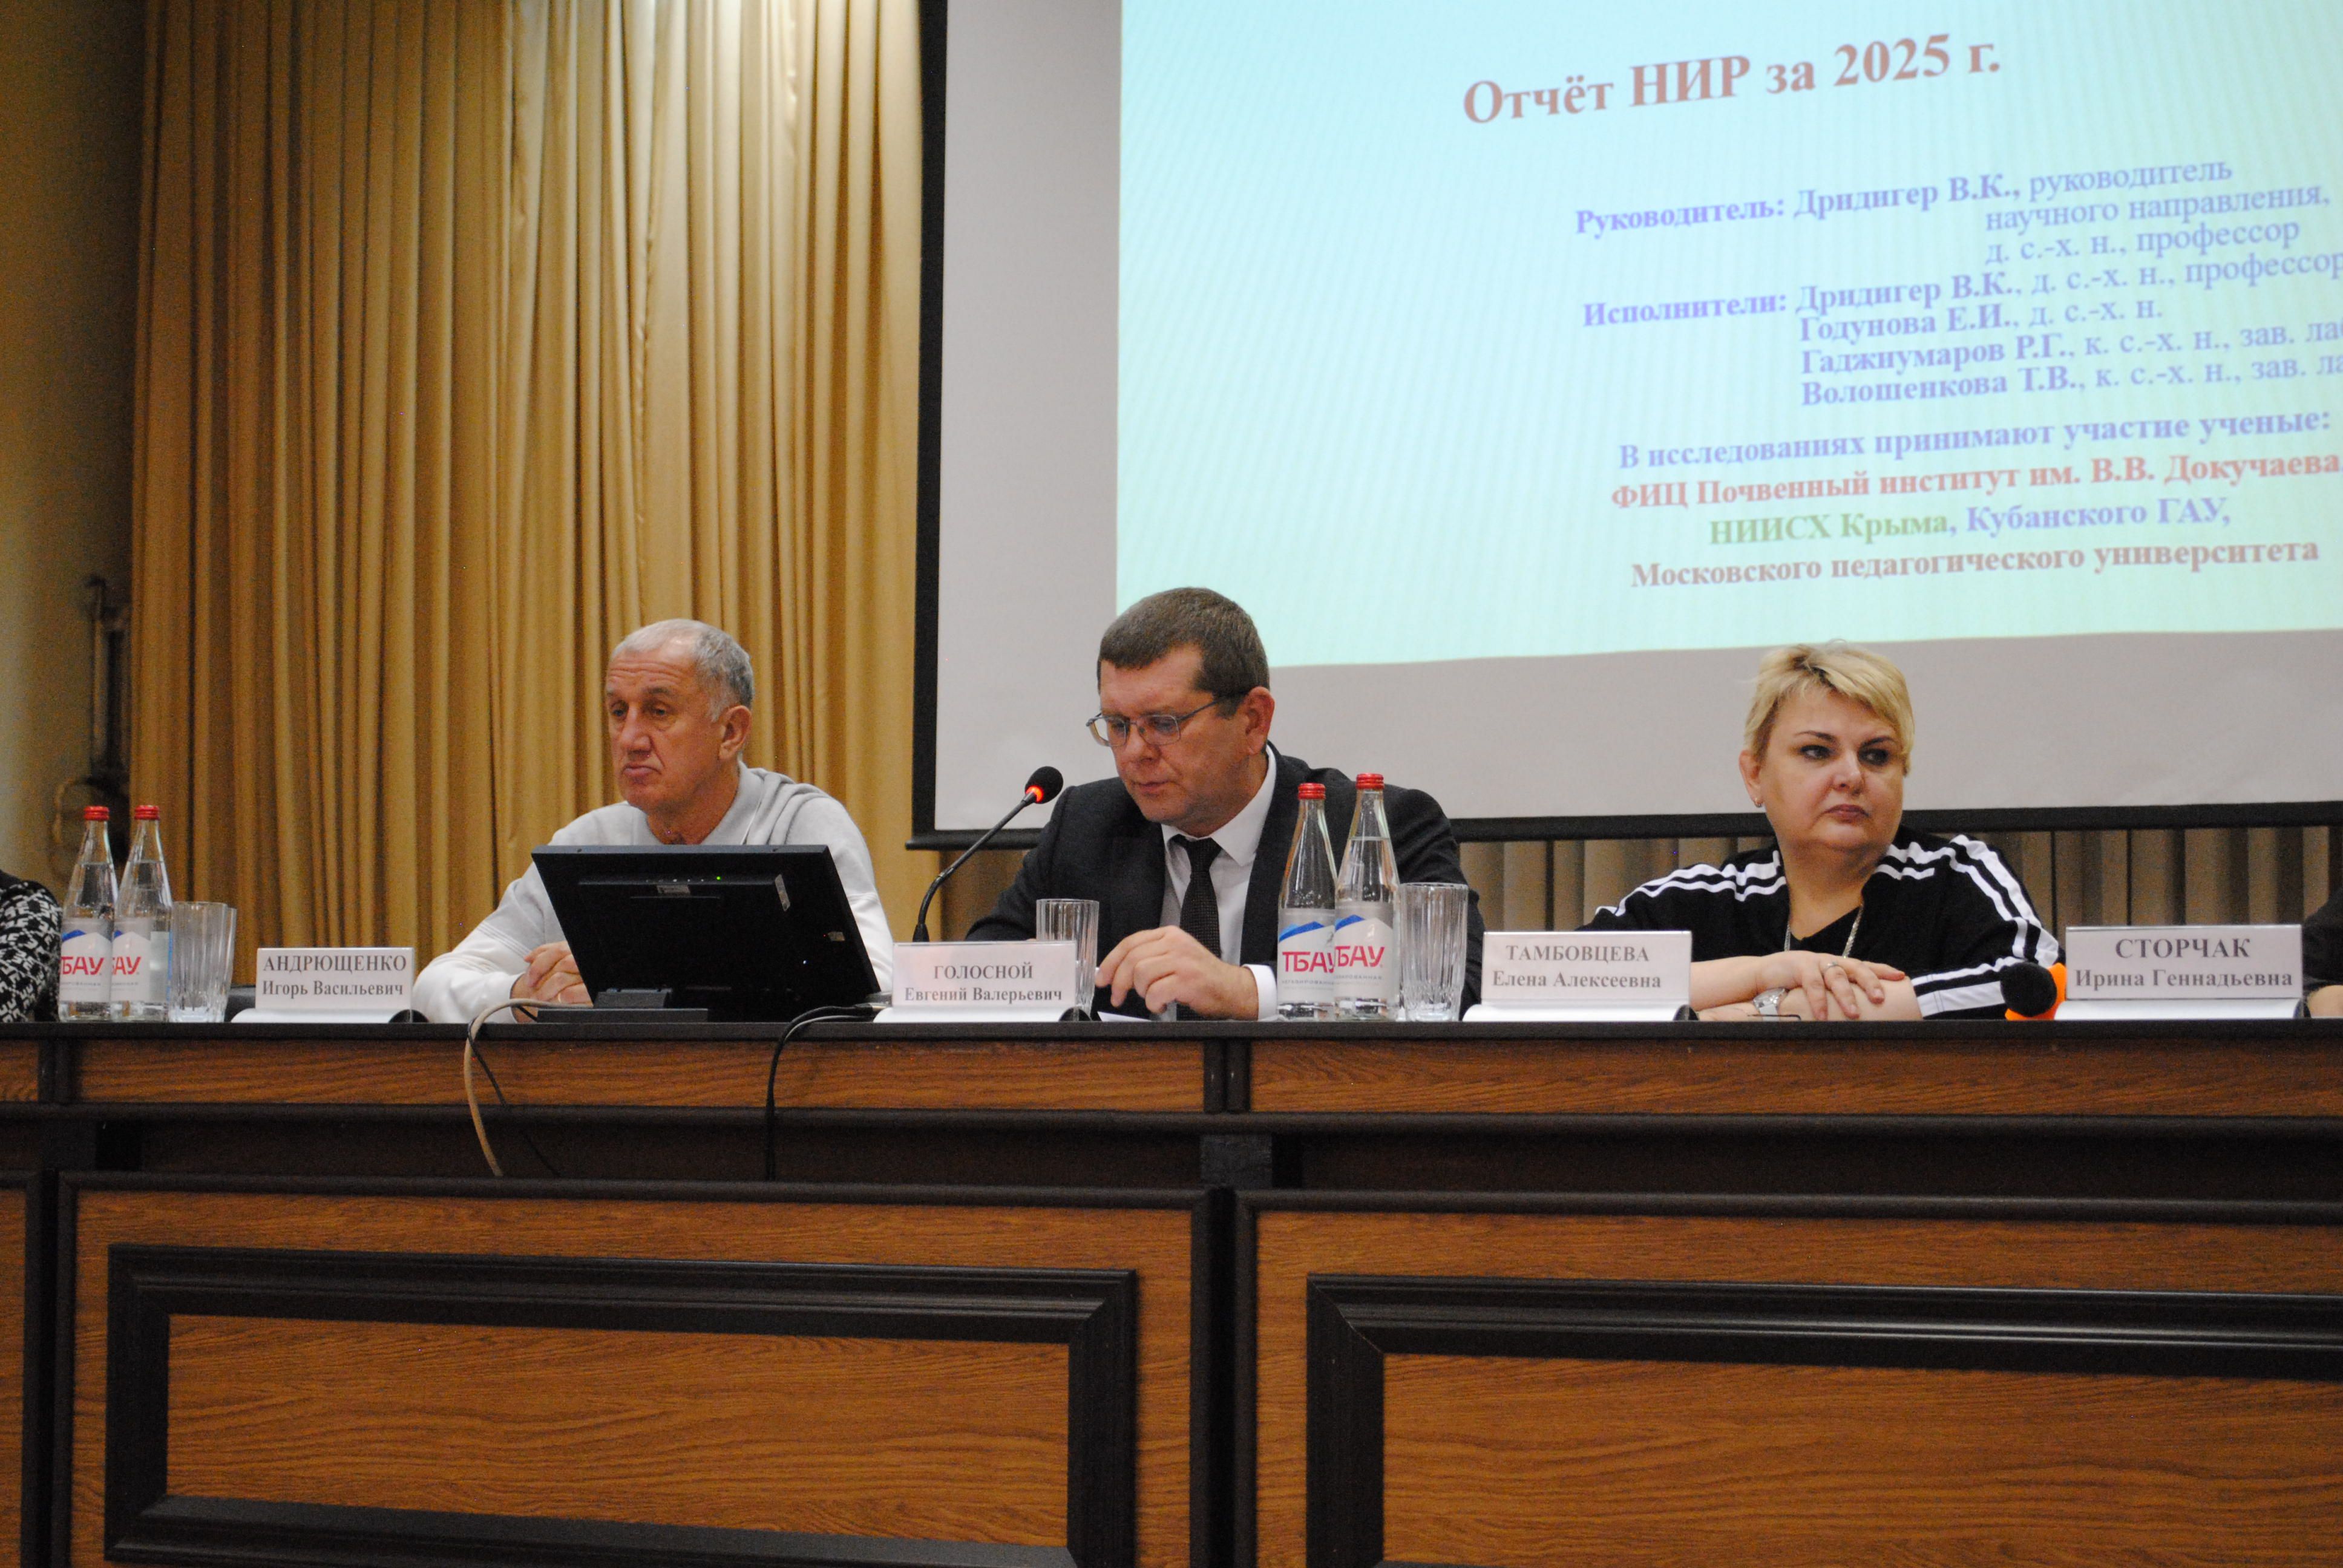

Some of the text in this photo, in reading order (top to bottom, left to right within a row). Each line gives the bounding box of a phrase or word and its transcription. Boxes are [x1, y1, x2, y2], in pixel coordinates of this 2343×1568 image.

[1463, 34, 2000, 123] Отчёт НИР за 2025 г.
[1575, 162, 2232, 239] Руководитель: Дридигер В.К., руководитель
[1986, 185, 2330, 235] научного направления,
[1985, 220, 2299, 264] д. с.-х. н., профессор
[1582, 293, 1786, 327] Исполнители:
[1795, 282, 1941, 315] Дридигер
[1951, 272, 2021, 299] В.К.,
[2031, 274, 2056, 294] д.
[2066, 268, 2127, 290] с.-х.
[2139, 266, 2174, 286] н.,
[1800, 299, 2163, 345] Годунова Е.И., д. с.-х. н.
[1801, 341, 2005, 376] Гаджиумаров
[2015, 334, 2074, 360] Р.Г.,
[2084, 336, 2108, 356] к.
[2120, 333, 2181, 353] с.-х.
[2194, 329, 2229, 351] н.,
[2240, 325, 2295, 347] зав.
[2019, 366, 2084, 392] Т.В.,
[2096, 368, 2119, 387] к.
[2130, 364, 2193, 385] с.-х.
[2204, 362, 2240, 384] н.,
[2251, 359, 2306, 380] зав.
[1619, 411, 2331, 468] В исследованиях принимают участие ученые:
[1611, 482, 1688, 509] ФИЦ
[1697, 470, 1869, 505] Почвенный
[1879, 468, 2020, 495] институт
[2029, 465, 2080, 486] им.
[2091, 456, 2154, 483] В.В.
[1710, 497, 2230, 544] НИИСХ Крыма, Кубанского ГАУ,
[1631, 541, 2318, 587] Московского педагогического университета
[263, 955, 406, 973] АНДРЮЩЕНКО
[934, 962, 1032, 979] ГОЛОСНОЙ
[1506, 946, 1649, 962] ТАМБОВЦЕВА
[2115, 938, 2250, 959] СТОРЧАК
[263, 981, 402, 999] Игорь Васильевич
[905, 987, 1062, 1004] Евгений Валерьевич
[1493, 971, 1661, 987] Елена Алексеевна
[2076, 969, 2292, 991] Ирина Геннадьевна
